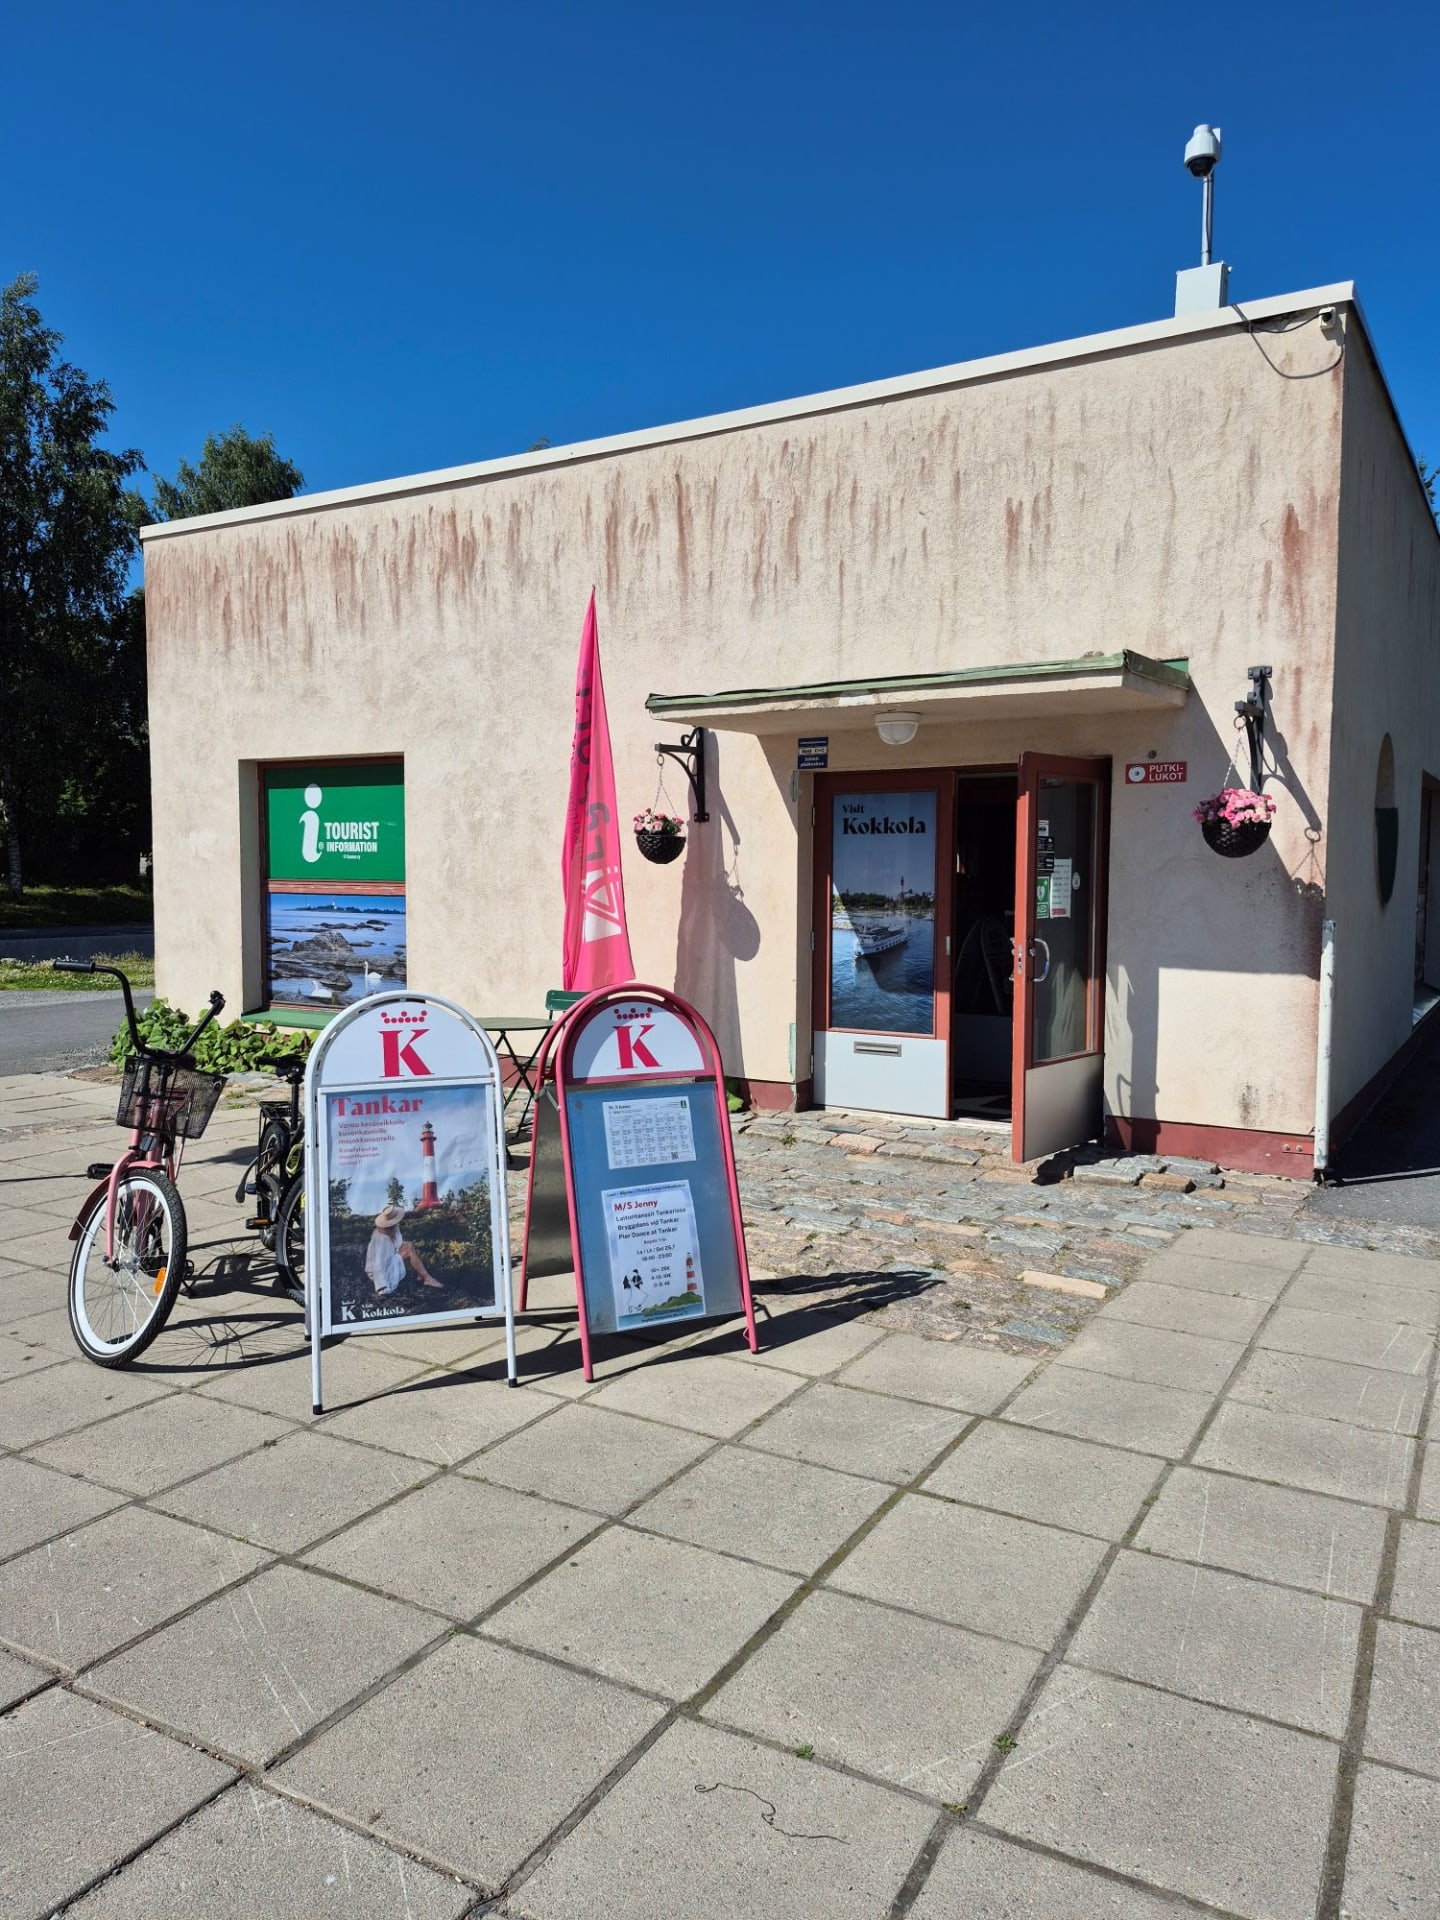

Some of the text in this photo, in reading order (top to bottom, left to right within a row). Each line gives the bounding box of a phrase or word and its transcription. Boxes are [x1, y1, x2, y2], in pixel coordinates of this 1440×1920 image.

[1149, 763, 1184, 772] PUTKI-
[1149, 772, 1184, 781] LUKOT
[842, 804, 865, 814] Visit
[324, 821, 379, 840] TOURIST
[842, 816, 926, 835] Kokkola
[326, 841, 378, 852] INFORMATION
[378, 1028, 435, 1078] K
[612, 1024, 663, 1070] K
[332, 1095, 423, 1117] Tankar
[614, 1200, 658, 1212] M/S Jenny
[631, 1230, 650, 1239] Dance
[658, 1226, 678, 1234] Tankar
[362, 1306, 405, 1319] Kokkola
